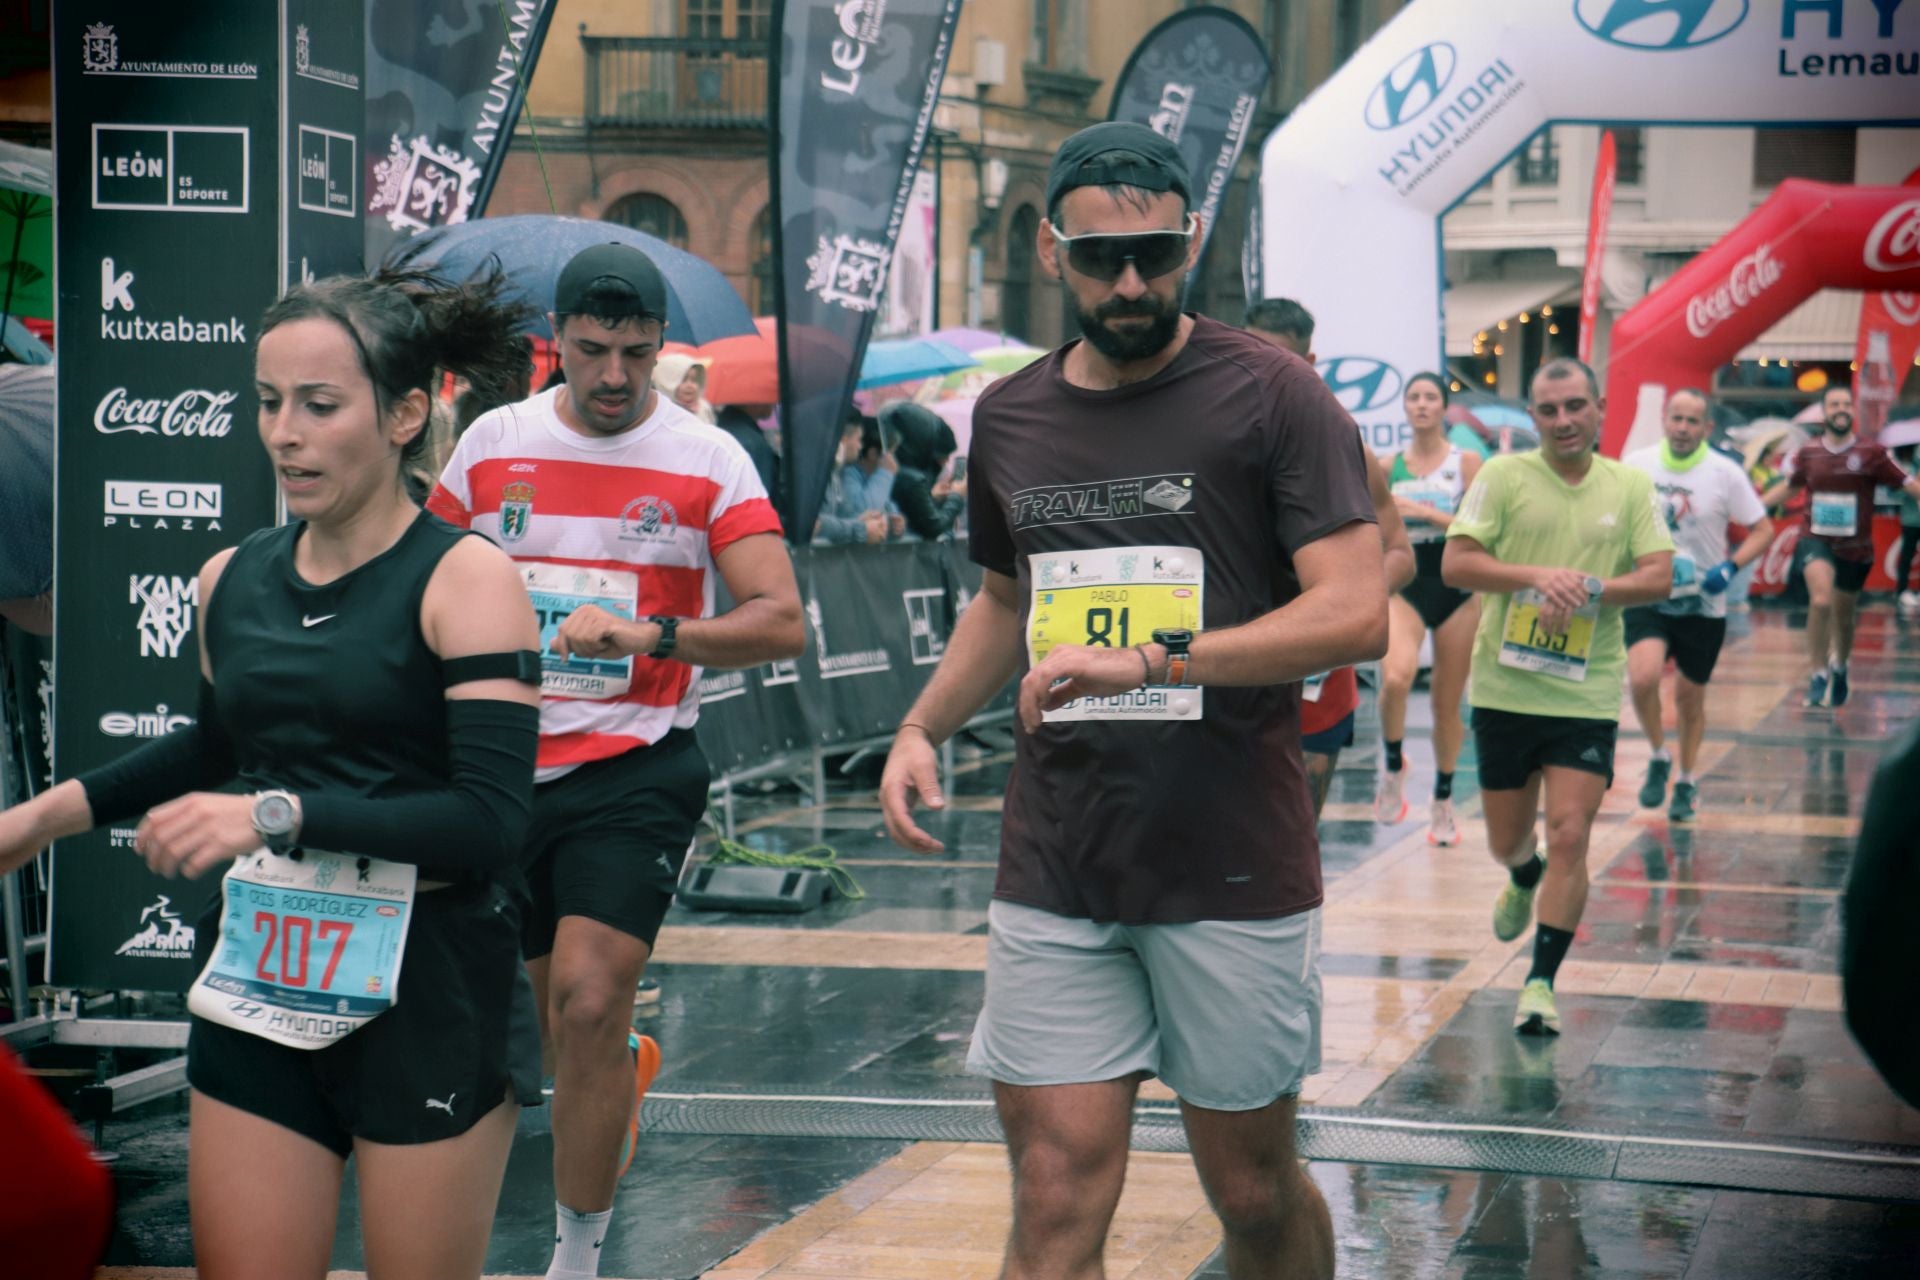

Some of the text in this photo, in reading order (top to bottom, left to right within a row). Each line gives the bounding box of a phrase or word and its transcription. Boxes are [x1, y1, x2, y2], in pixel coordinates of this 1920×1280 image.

[120, 61, 258, 76] AYUNTAMIENTO DE LEÓN
[1778, 48, 1920, 77] Lemau
[1378, 57, 1515, 186] HYUNDAI
[102, 151, 164, 178] LEÓN
[302, 153, 326, 181] LEÓN
[179, 176, 193, 187] ES
[179, 189, 229, 201] DEPORTE
[1686, 243, 1784, 338] Coca-Cola
[101, 315, 246, 344] kutxabank
[94, 387, 239, 438] Coca-Cola
[110, 487, 217, 510] LEON
[1011, 488, 1109, 526] TRAIL
[103, 515, 222, 532] PLAZA
[1090, 589, 1129, 603] PABLO
[1085, 607, 1130, 648] 81
[281, 895, 369, 918] RODRÍGUEZ
[125, 949, 192, 959] ATLETISMO LEÓN
[254, 911, 355, 991] 207
